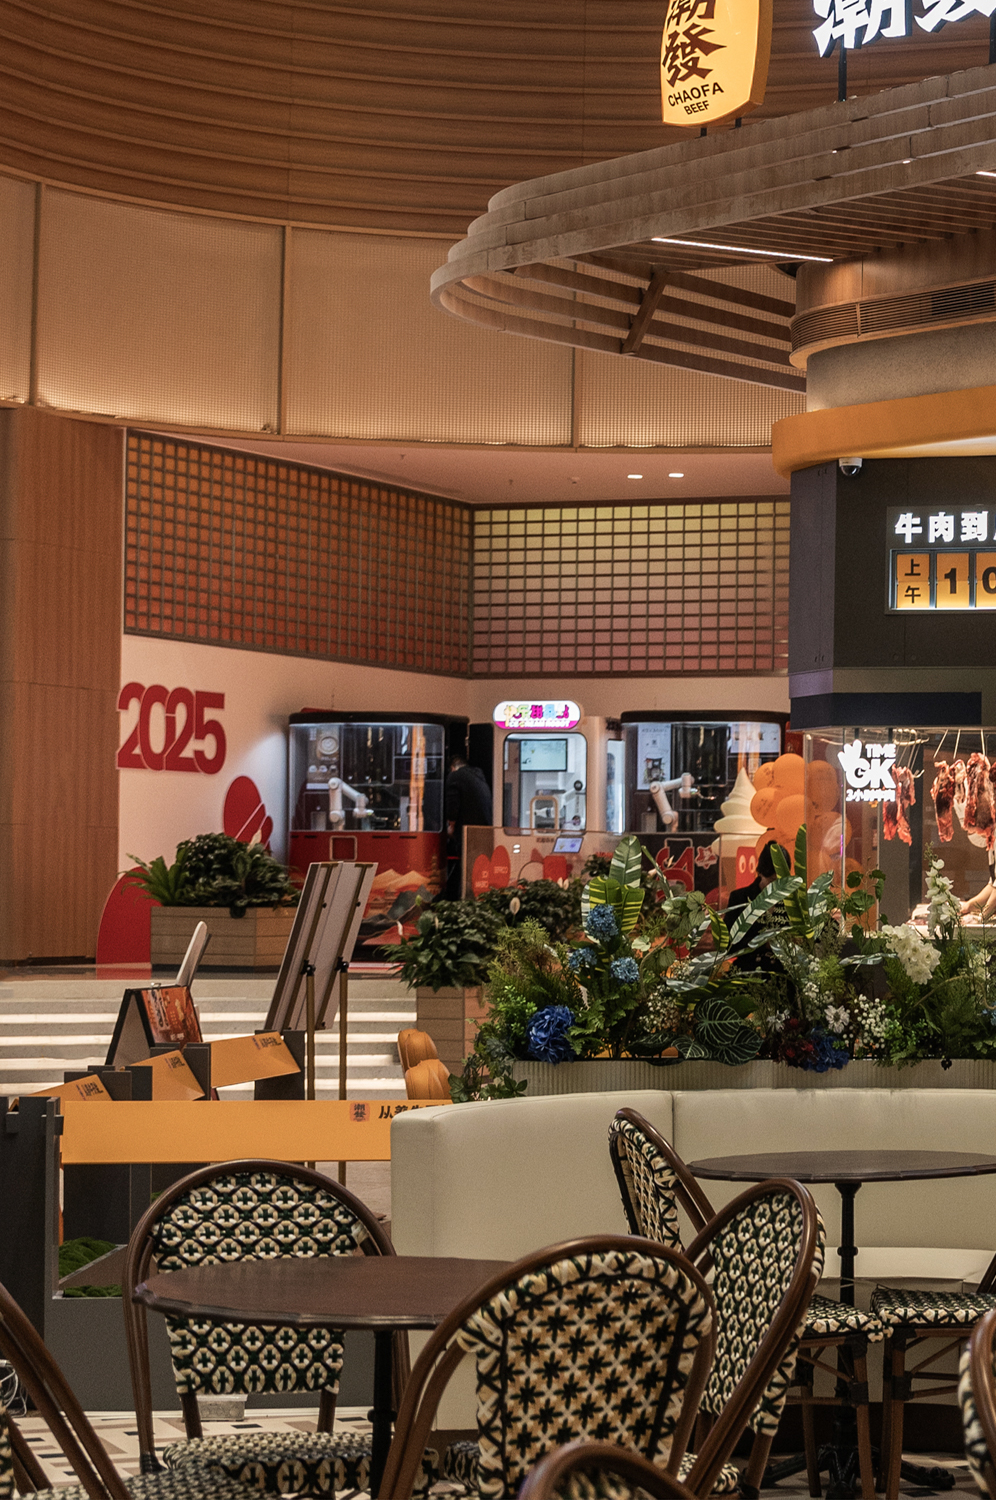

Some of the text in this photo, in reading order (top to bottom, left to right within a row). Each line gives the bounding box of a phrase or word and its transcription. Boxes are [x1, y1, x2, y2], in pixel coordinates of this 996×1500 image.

[667, 82, 724, 107] CHAOFA
[684, 100, 710, 115] BEEF
[904, 559, 921, 604] 上午
[117, 682, 226, 775] 2025
[865, 743, 897, 758] TIME
